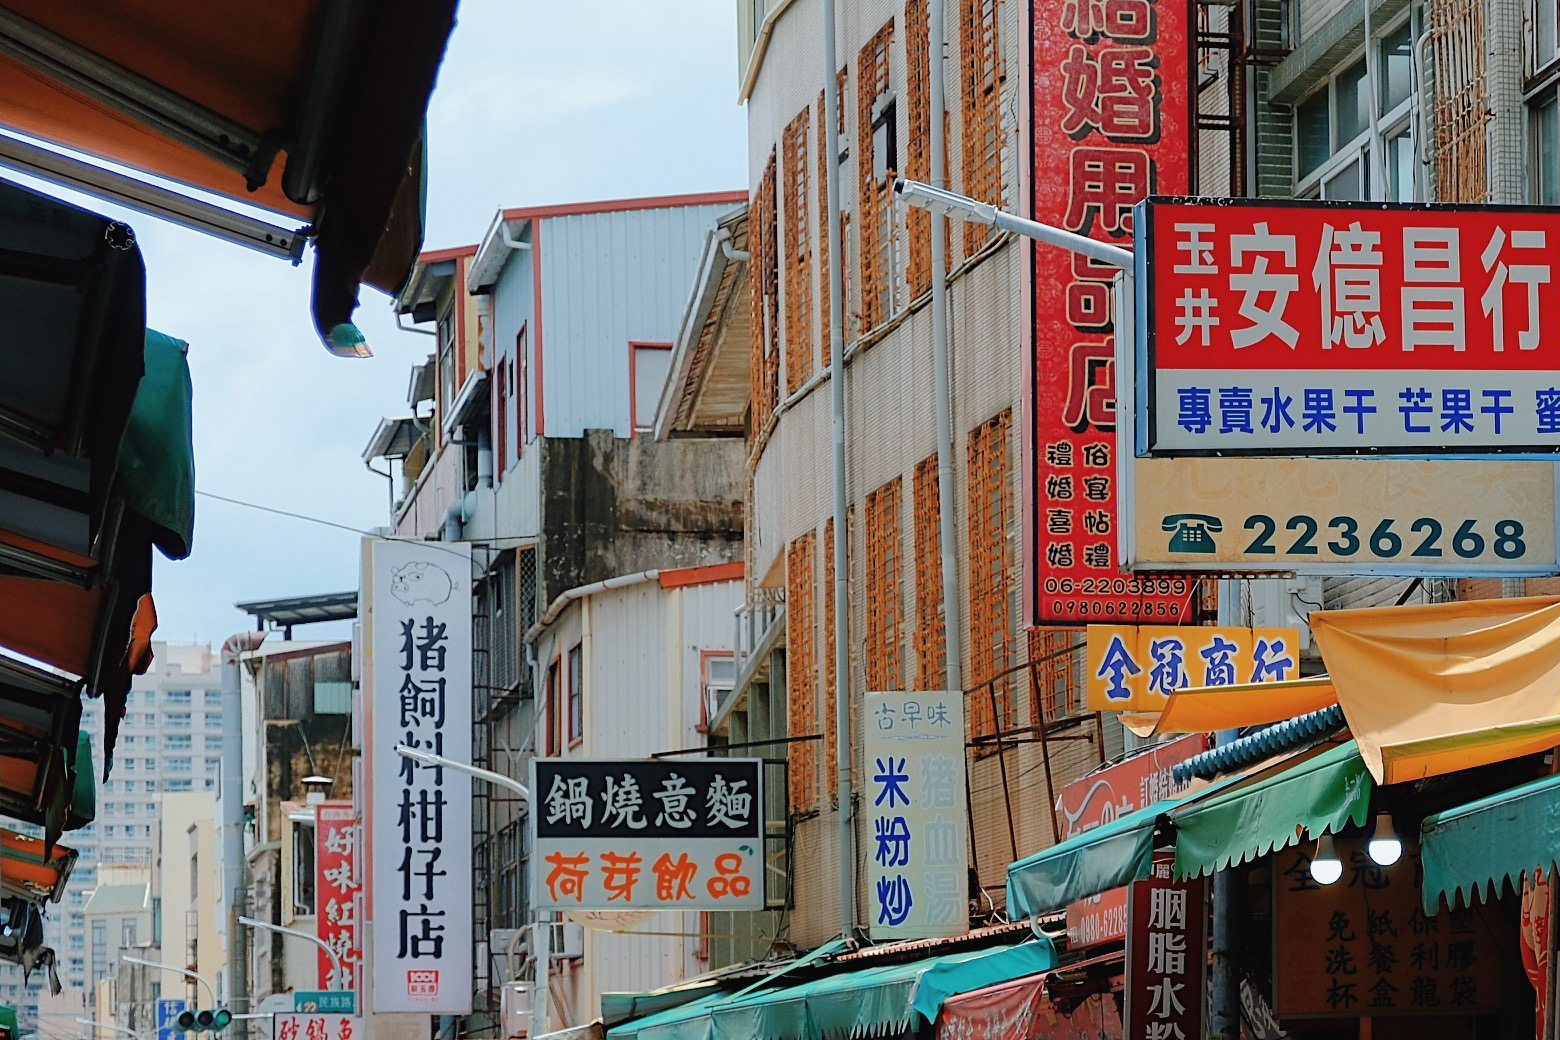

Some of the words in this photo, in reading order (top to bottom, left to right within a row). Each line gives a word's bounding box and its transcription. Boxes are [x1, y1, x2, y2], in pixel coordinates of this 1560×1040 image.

[1173, 222, 1219, 347] 玉井
[1229, 221, 1550, 353] 安億昌行
[1177, 386, 1379, 435] 專賣水果干
[1398, 387, 1514, 434] 芒果干
[1244, 515, 1527, 560] 2236268
[1044, 577, 1187, 597] 06-2203899
[1052, 600, 1181, 618] 0980622856
[1097, 634, 1294, 699] 全冠商行
[874, 701, 952, 730] 古早味
[544, 774, 753, 831] 鍋燒意麵
[873, 756, 913, 926] 米粉炒
[544, 851, 753, 903] 荷芽飲品
[1283, 851, 1422, 893] 全冠
[1325, 910, 1358, 1010] 免洗杯
[1366, 909, 1399, 1008] 紙餐盒
[1408, 906, 1441, 1008] 保利龍
[1446, 907, 1480, 1008] 塑膠袋
